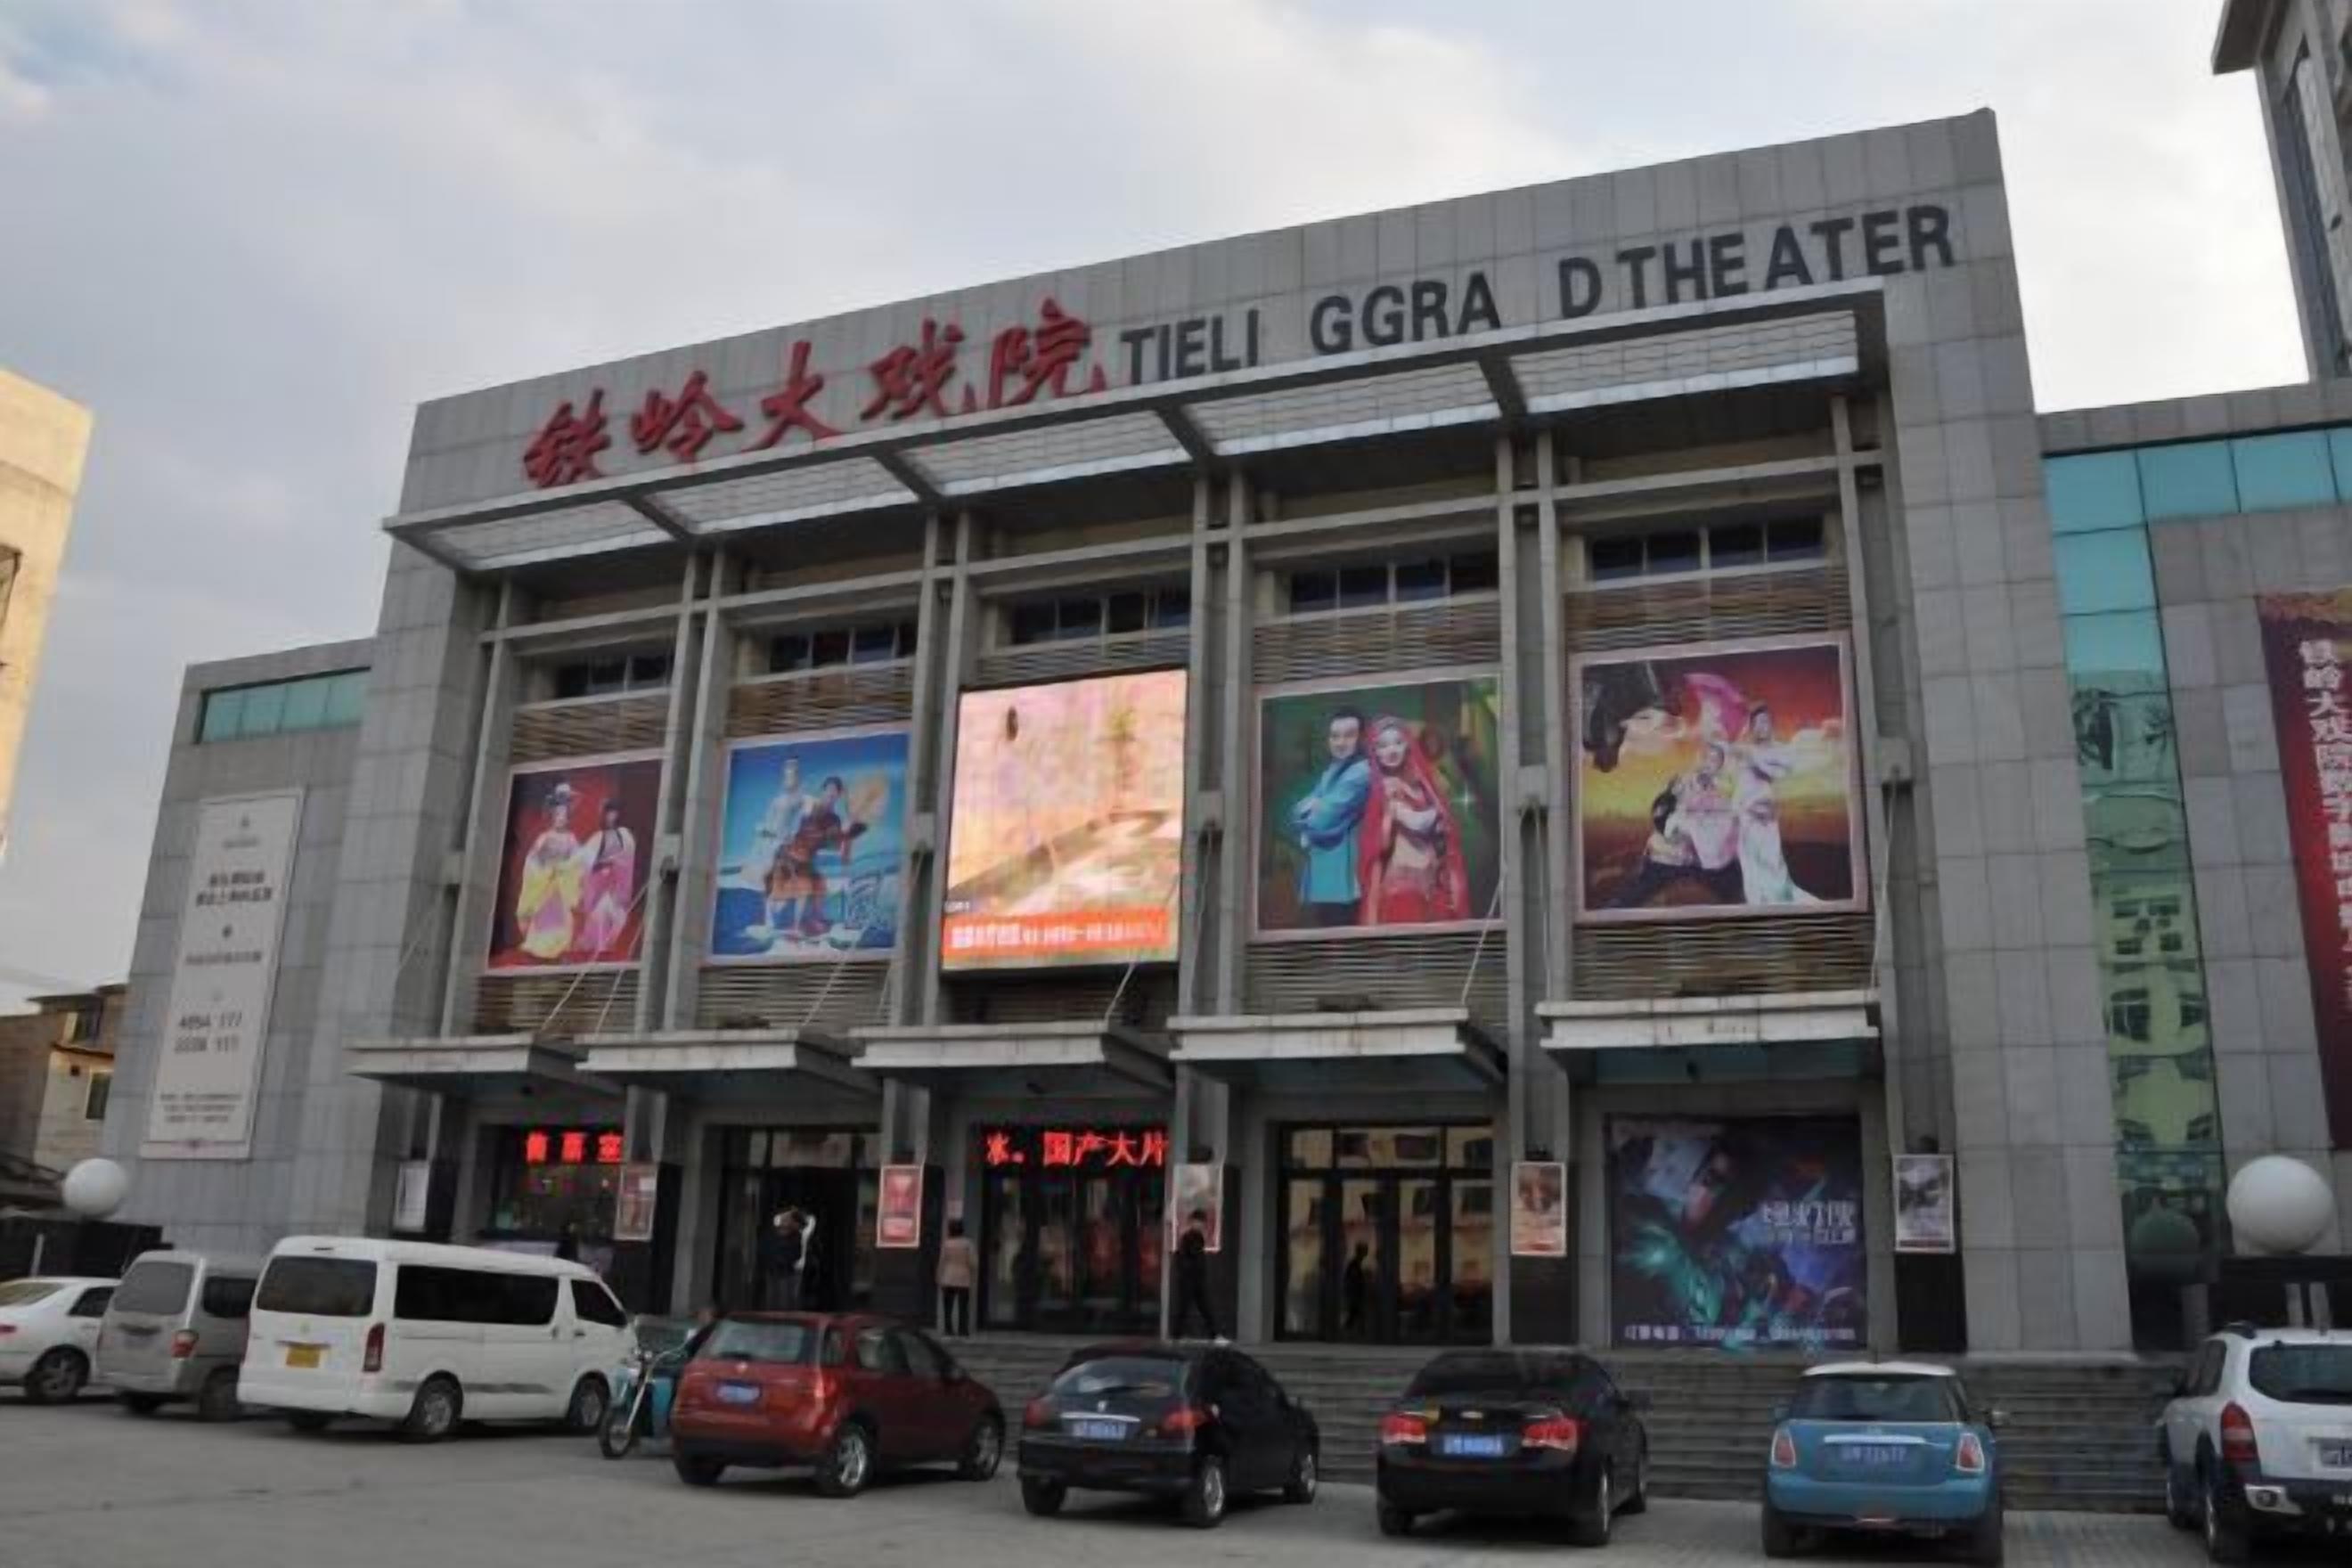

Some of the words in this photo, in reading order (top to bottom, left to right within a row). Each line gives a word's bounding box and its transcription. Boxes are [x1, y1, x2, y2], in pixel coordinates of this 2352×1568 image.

[524, 295, 1107, 487] 铁岭大戏院
[1119, 308, 1261, 383] TIELI
